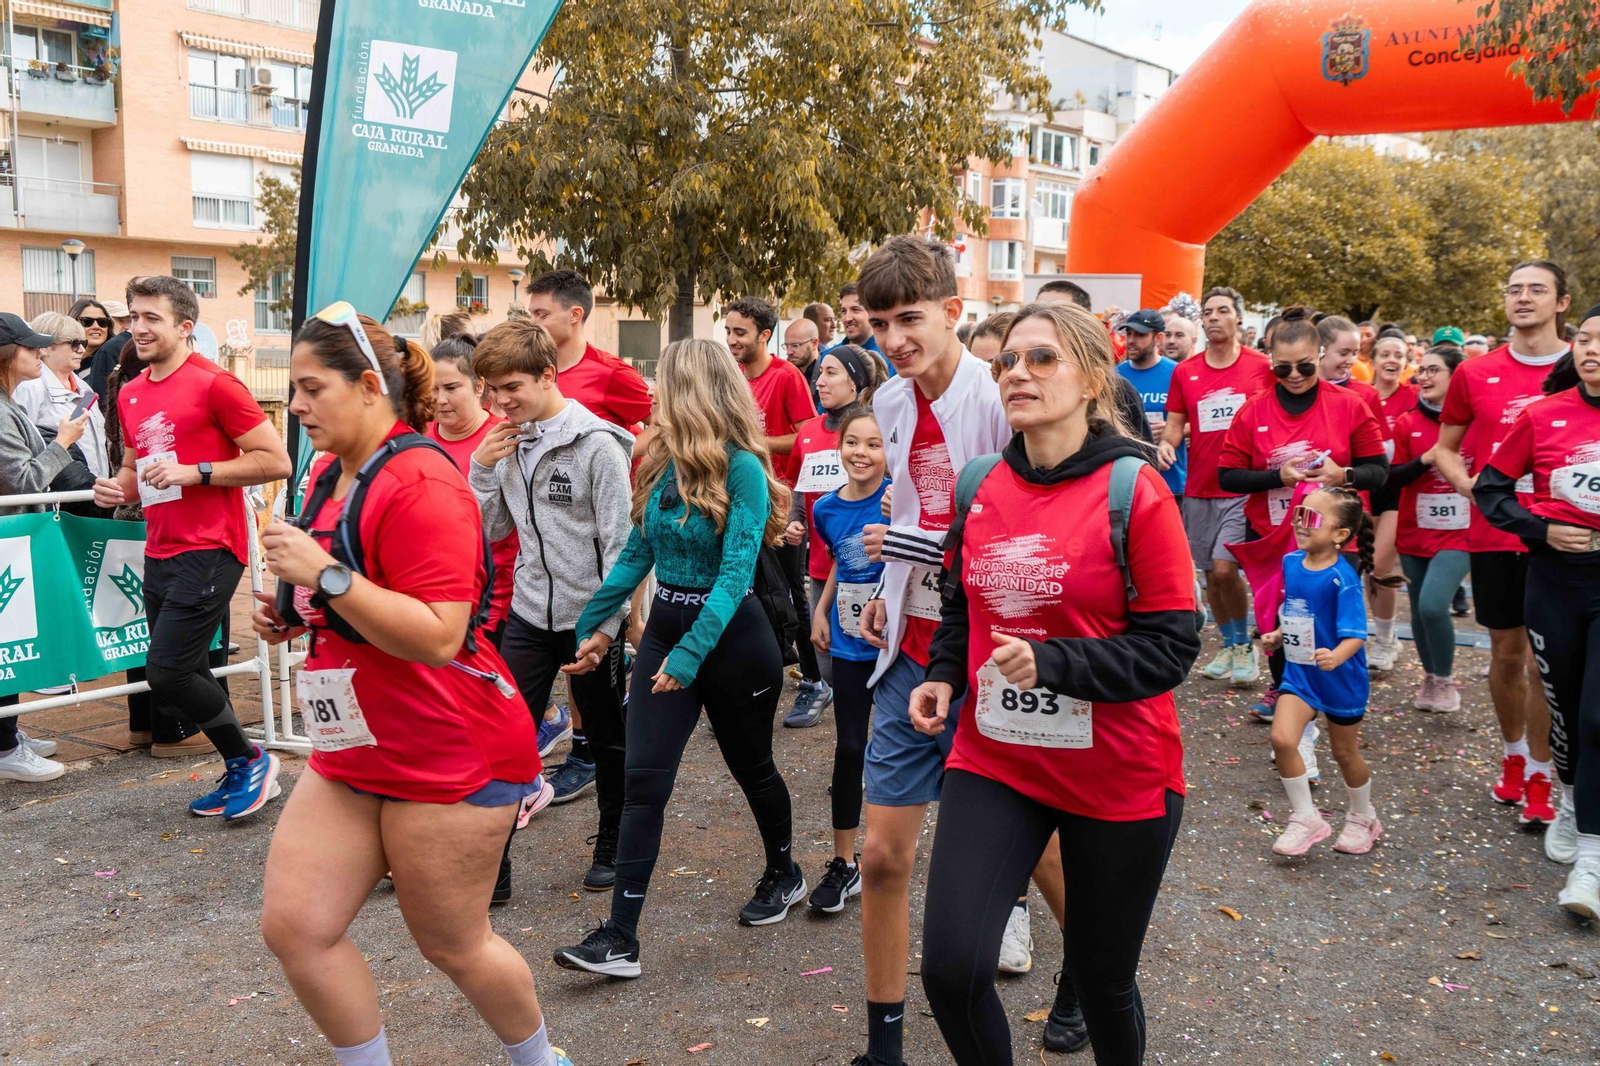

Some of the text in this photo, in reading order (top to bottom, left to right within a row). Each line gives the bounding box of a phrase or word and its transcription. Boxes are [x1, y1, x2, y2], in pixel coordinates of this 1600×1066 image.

[418, 0, 495, 18] GRANADA
[352, 41, 370, 120] fundación
[352, 123, 448, 150] CAJA RURAL
[368, 141, 424, 158] GRANADA
[1211, 406, 1234, 418] 212
[811, 464, 839, 476] 1215
[549, 482, 572, 495] CXM
[1429, 505, 1456, 517] 381
[967, 573, 1063, 595] HUMANIDAD
[105, 640, 151, 660] GRANA
[308, 698, 341, 723] 181
[1001, 688, 1060, 715] 893
